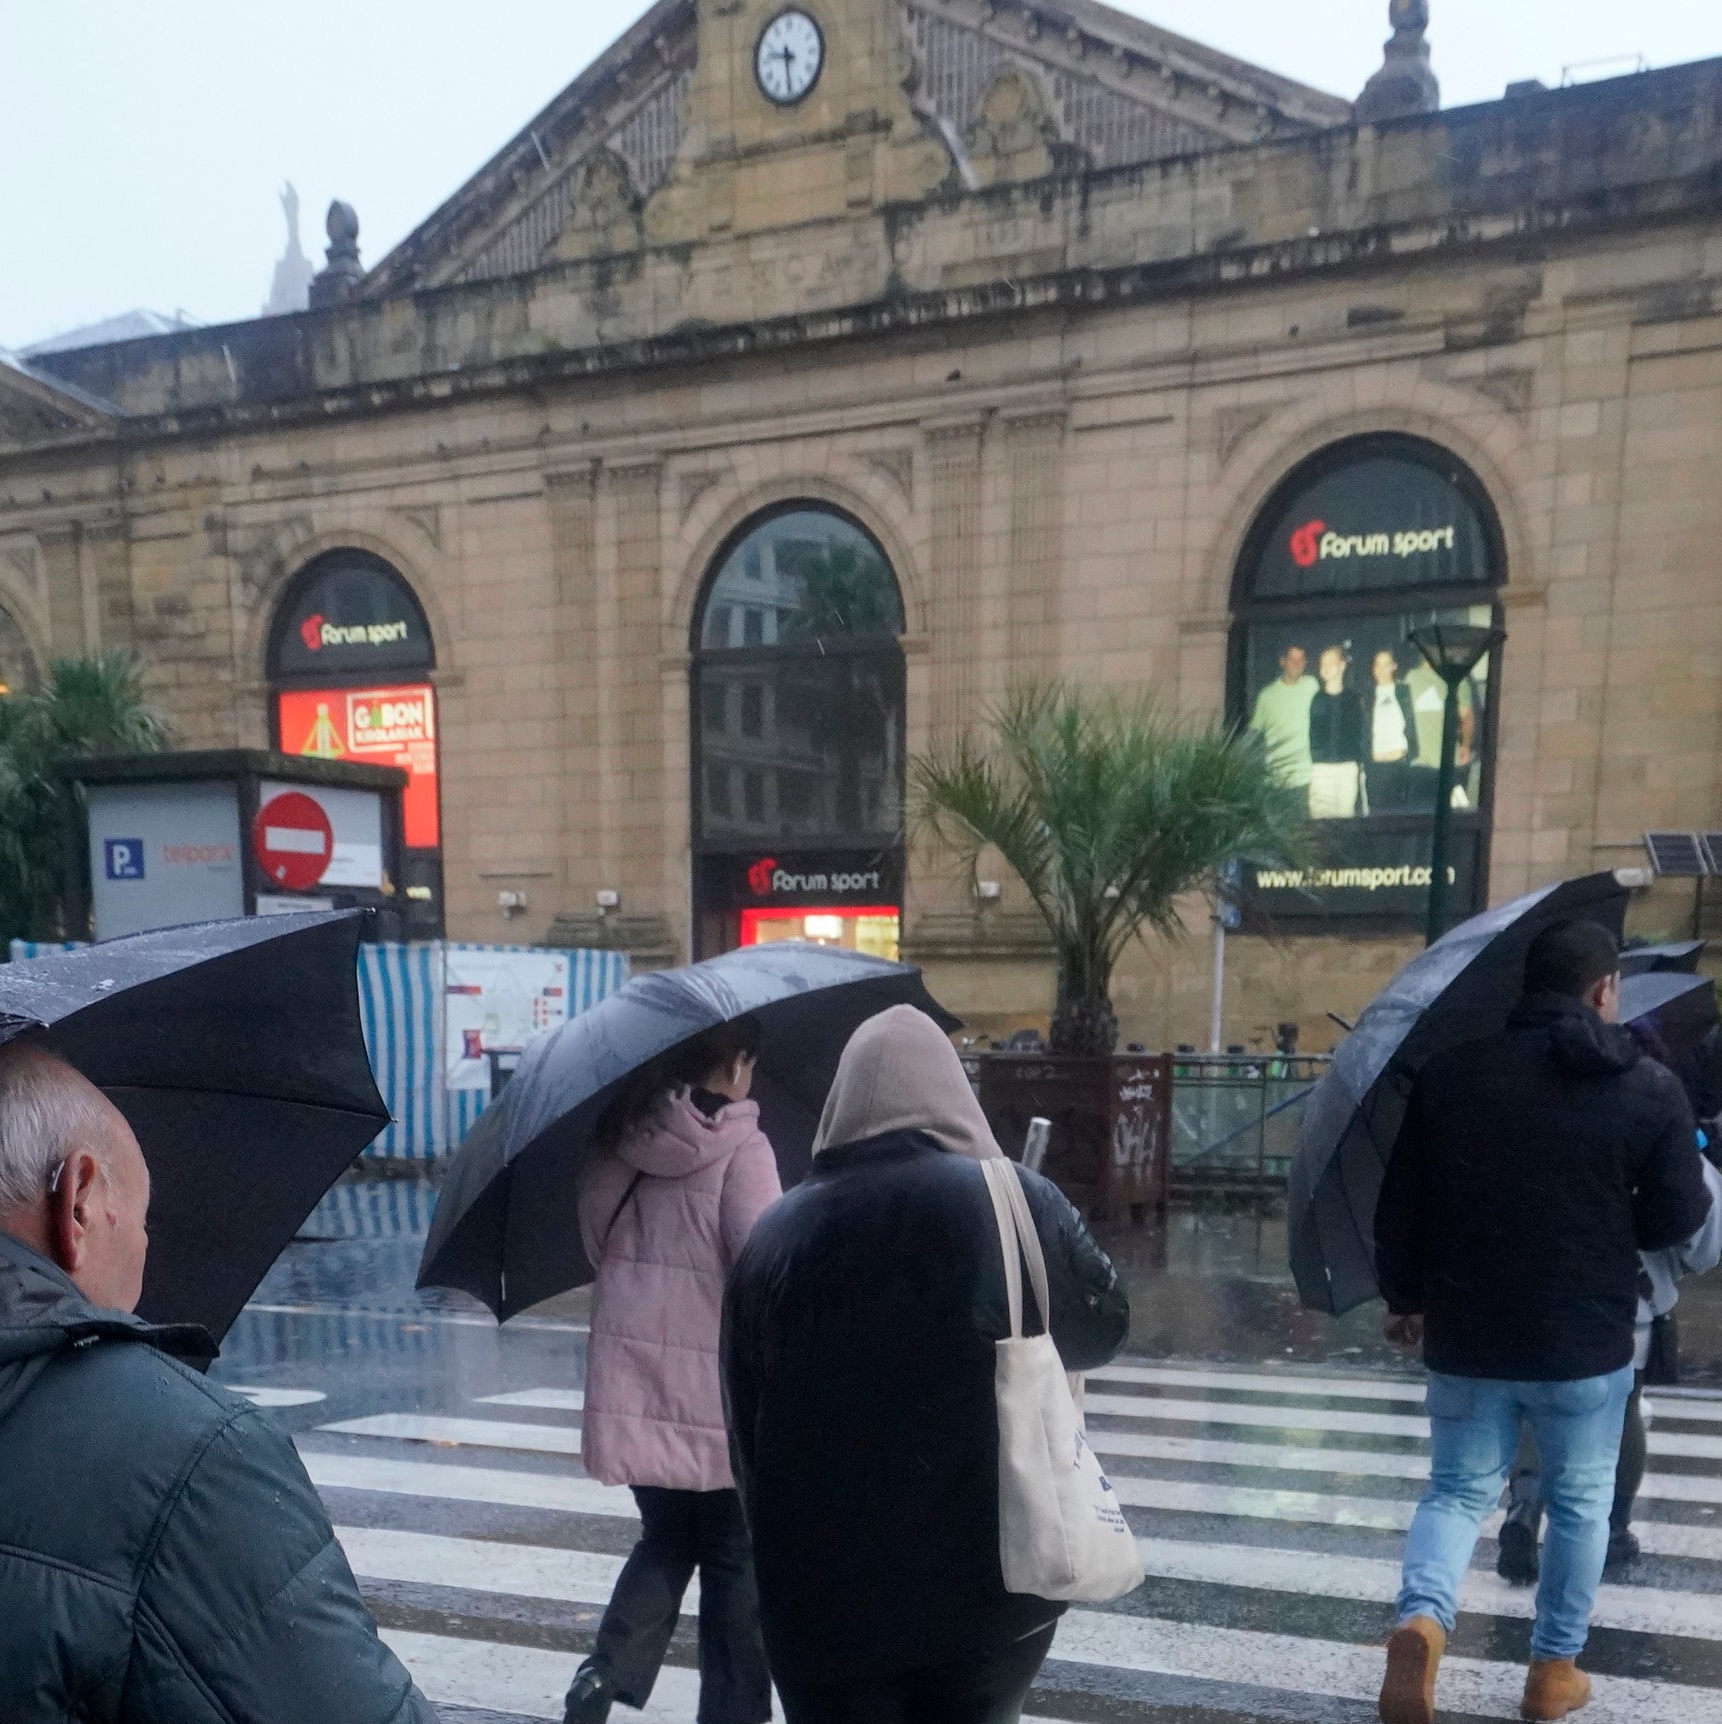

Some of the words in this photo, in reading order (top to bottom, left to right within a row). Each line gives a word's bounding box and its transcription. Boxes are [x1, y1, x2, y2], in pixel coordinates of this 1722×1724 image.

[1320, 532, 1390, 560] forum
[1393, 525, 1454, 558] sport
[321, 623, 367, 646] forum
[367, 621, 408, 646] sport
[113, 844, 131, 876] P
[773, 869, 827, 891] forum
[831, 870, 879, 893] sport
